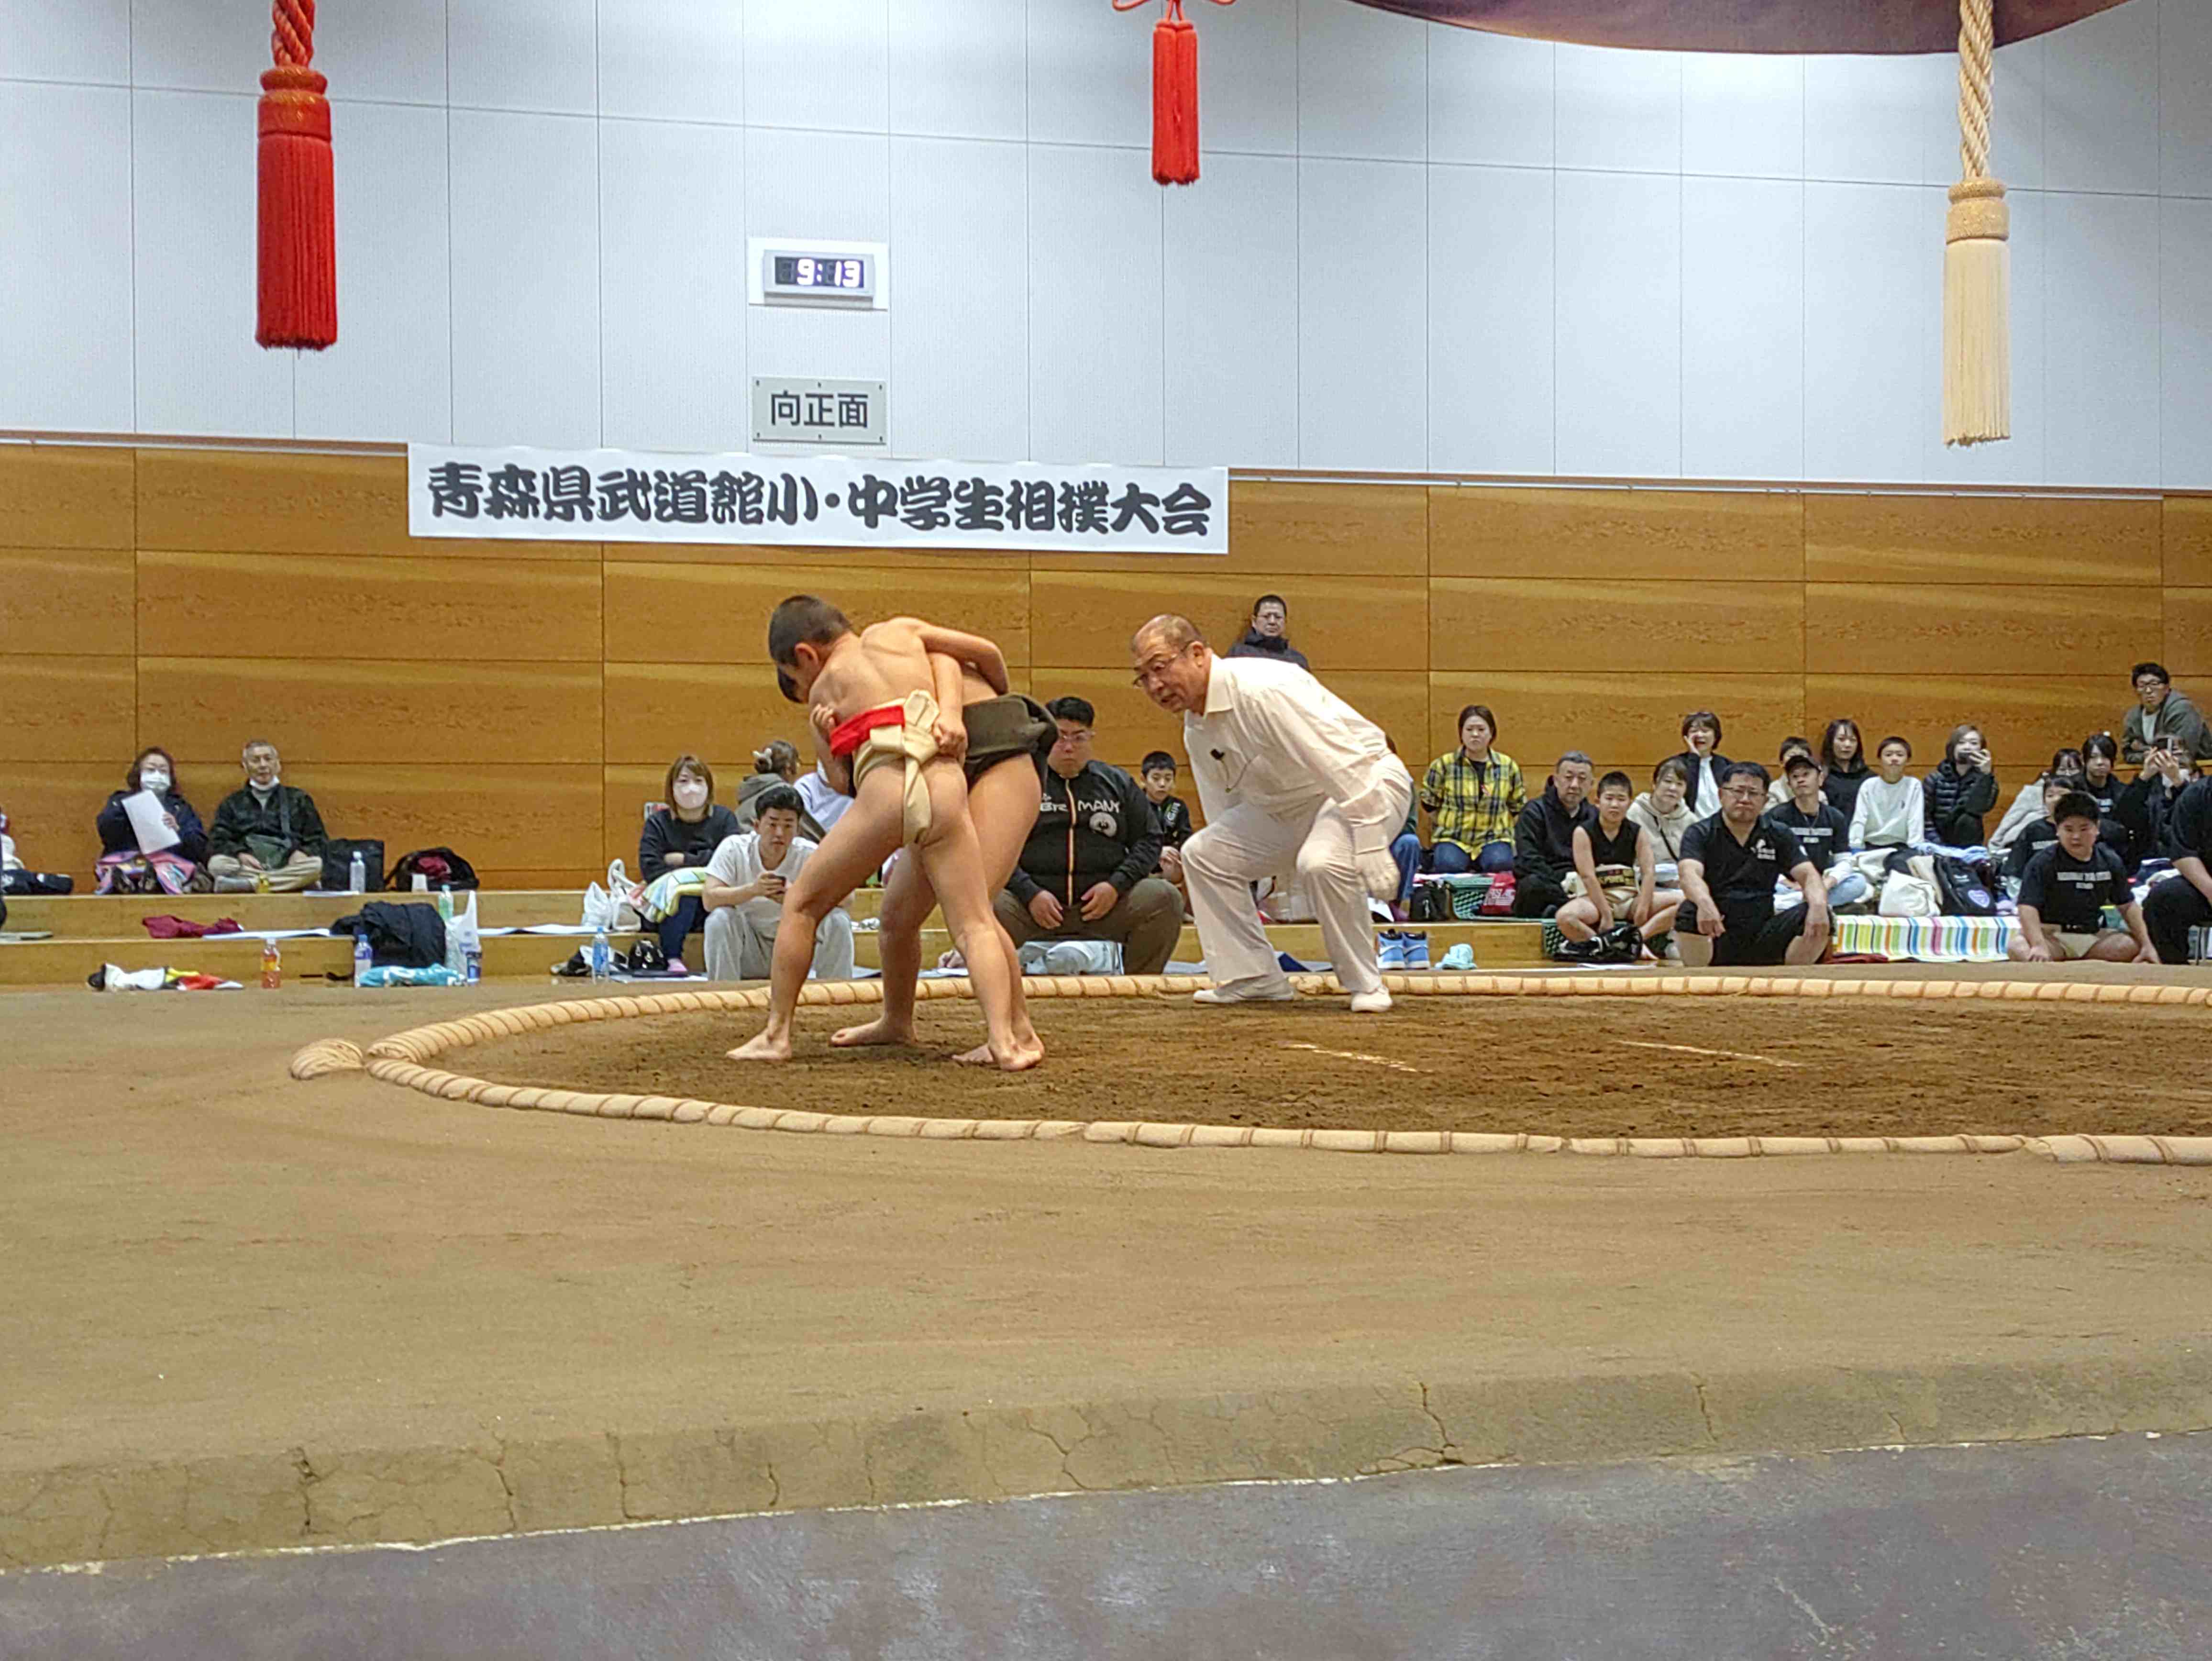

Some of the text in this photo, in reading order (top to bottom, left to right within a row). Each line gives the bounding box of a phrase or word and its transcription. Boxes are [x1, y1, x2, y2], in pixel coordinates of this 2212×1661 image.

[796, 258, 860, 287] 9:13
[771, 390, 868, 428] 向正面
